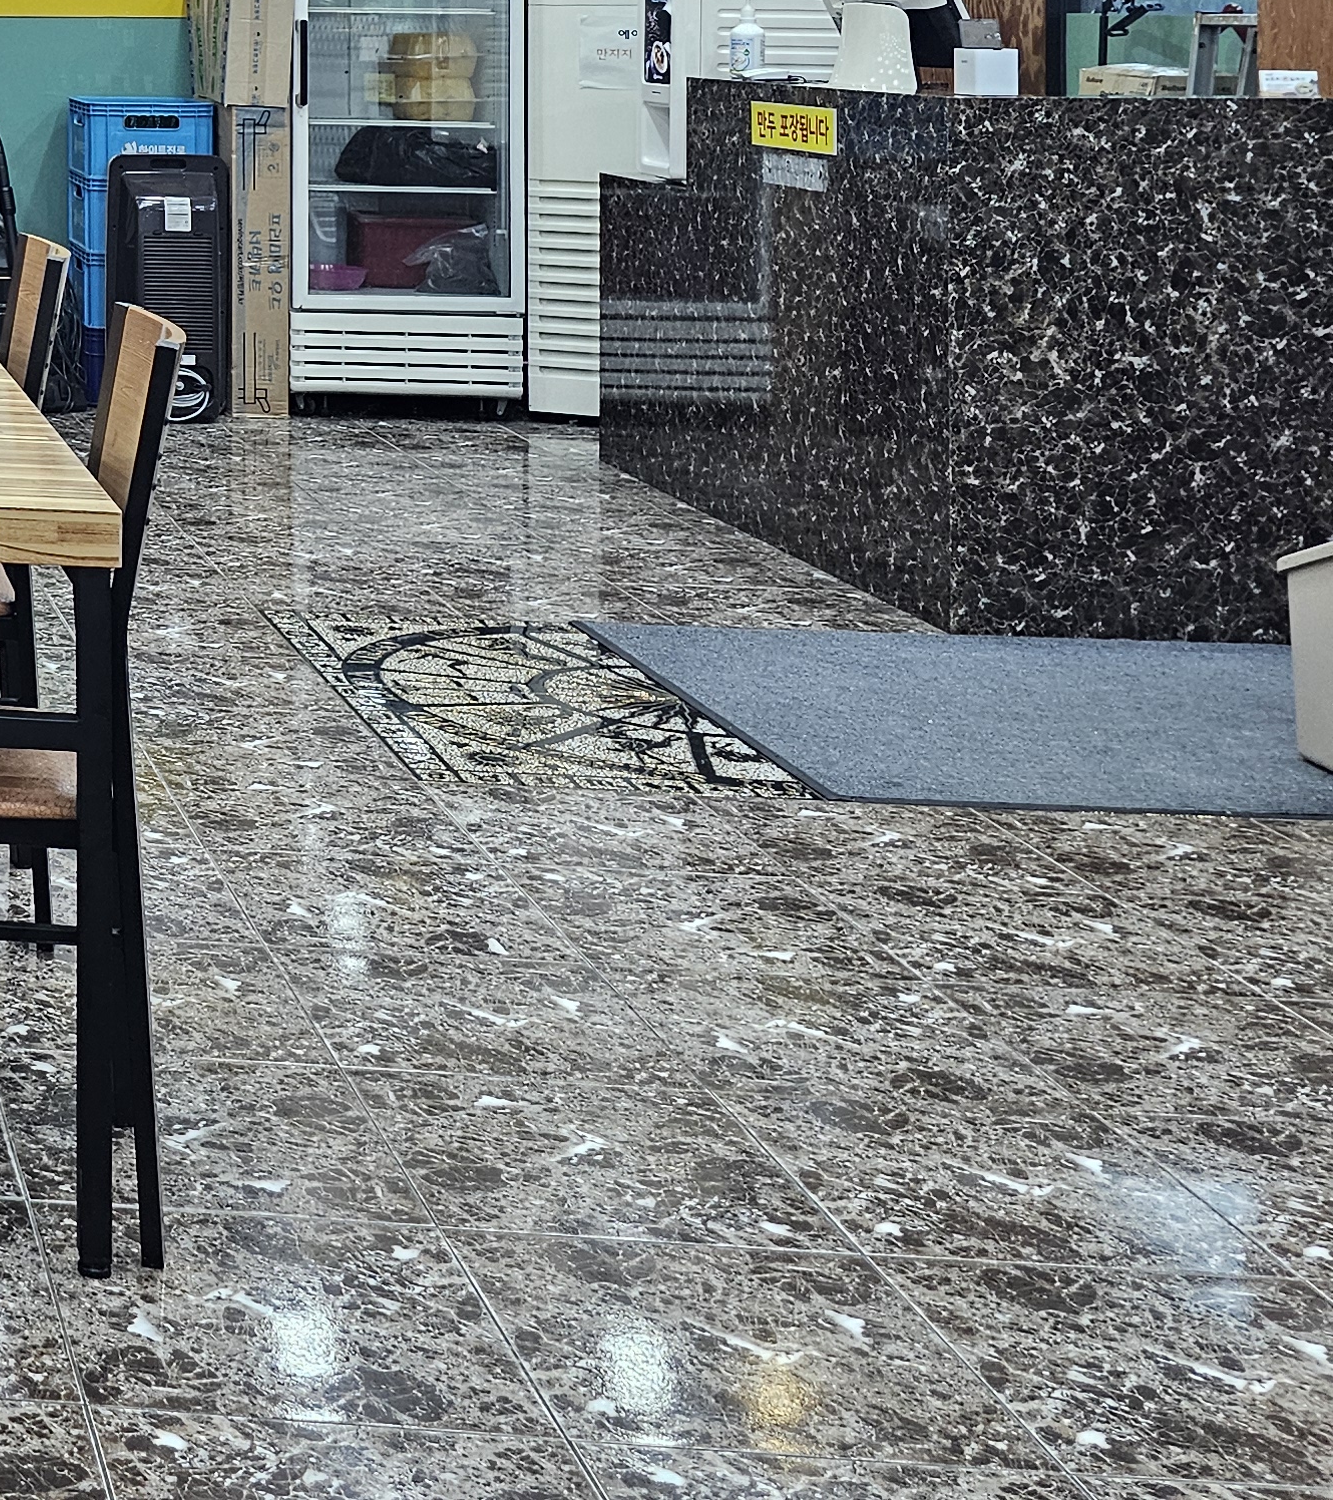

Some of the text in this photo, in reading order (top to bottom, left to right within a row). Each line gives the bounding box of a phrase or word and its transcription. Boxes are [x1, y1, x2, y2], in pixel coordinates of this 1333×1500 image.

[596, 48, 632, 60] 만지지
[756, 109, 830, 146] 만두 포장됩니다
[267, 280, 283, 311] 우드
